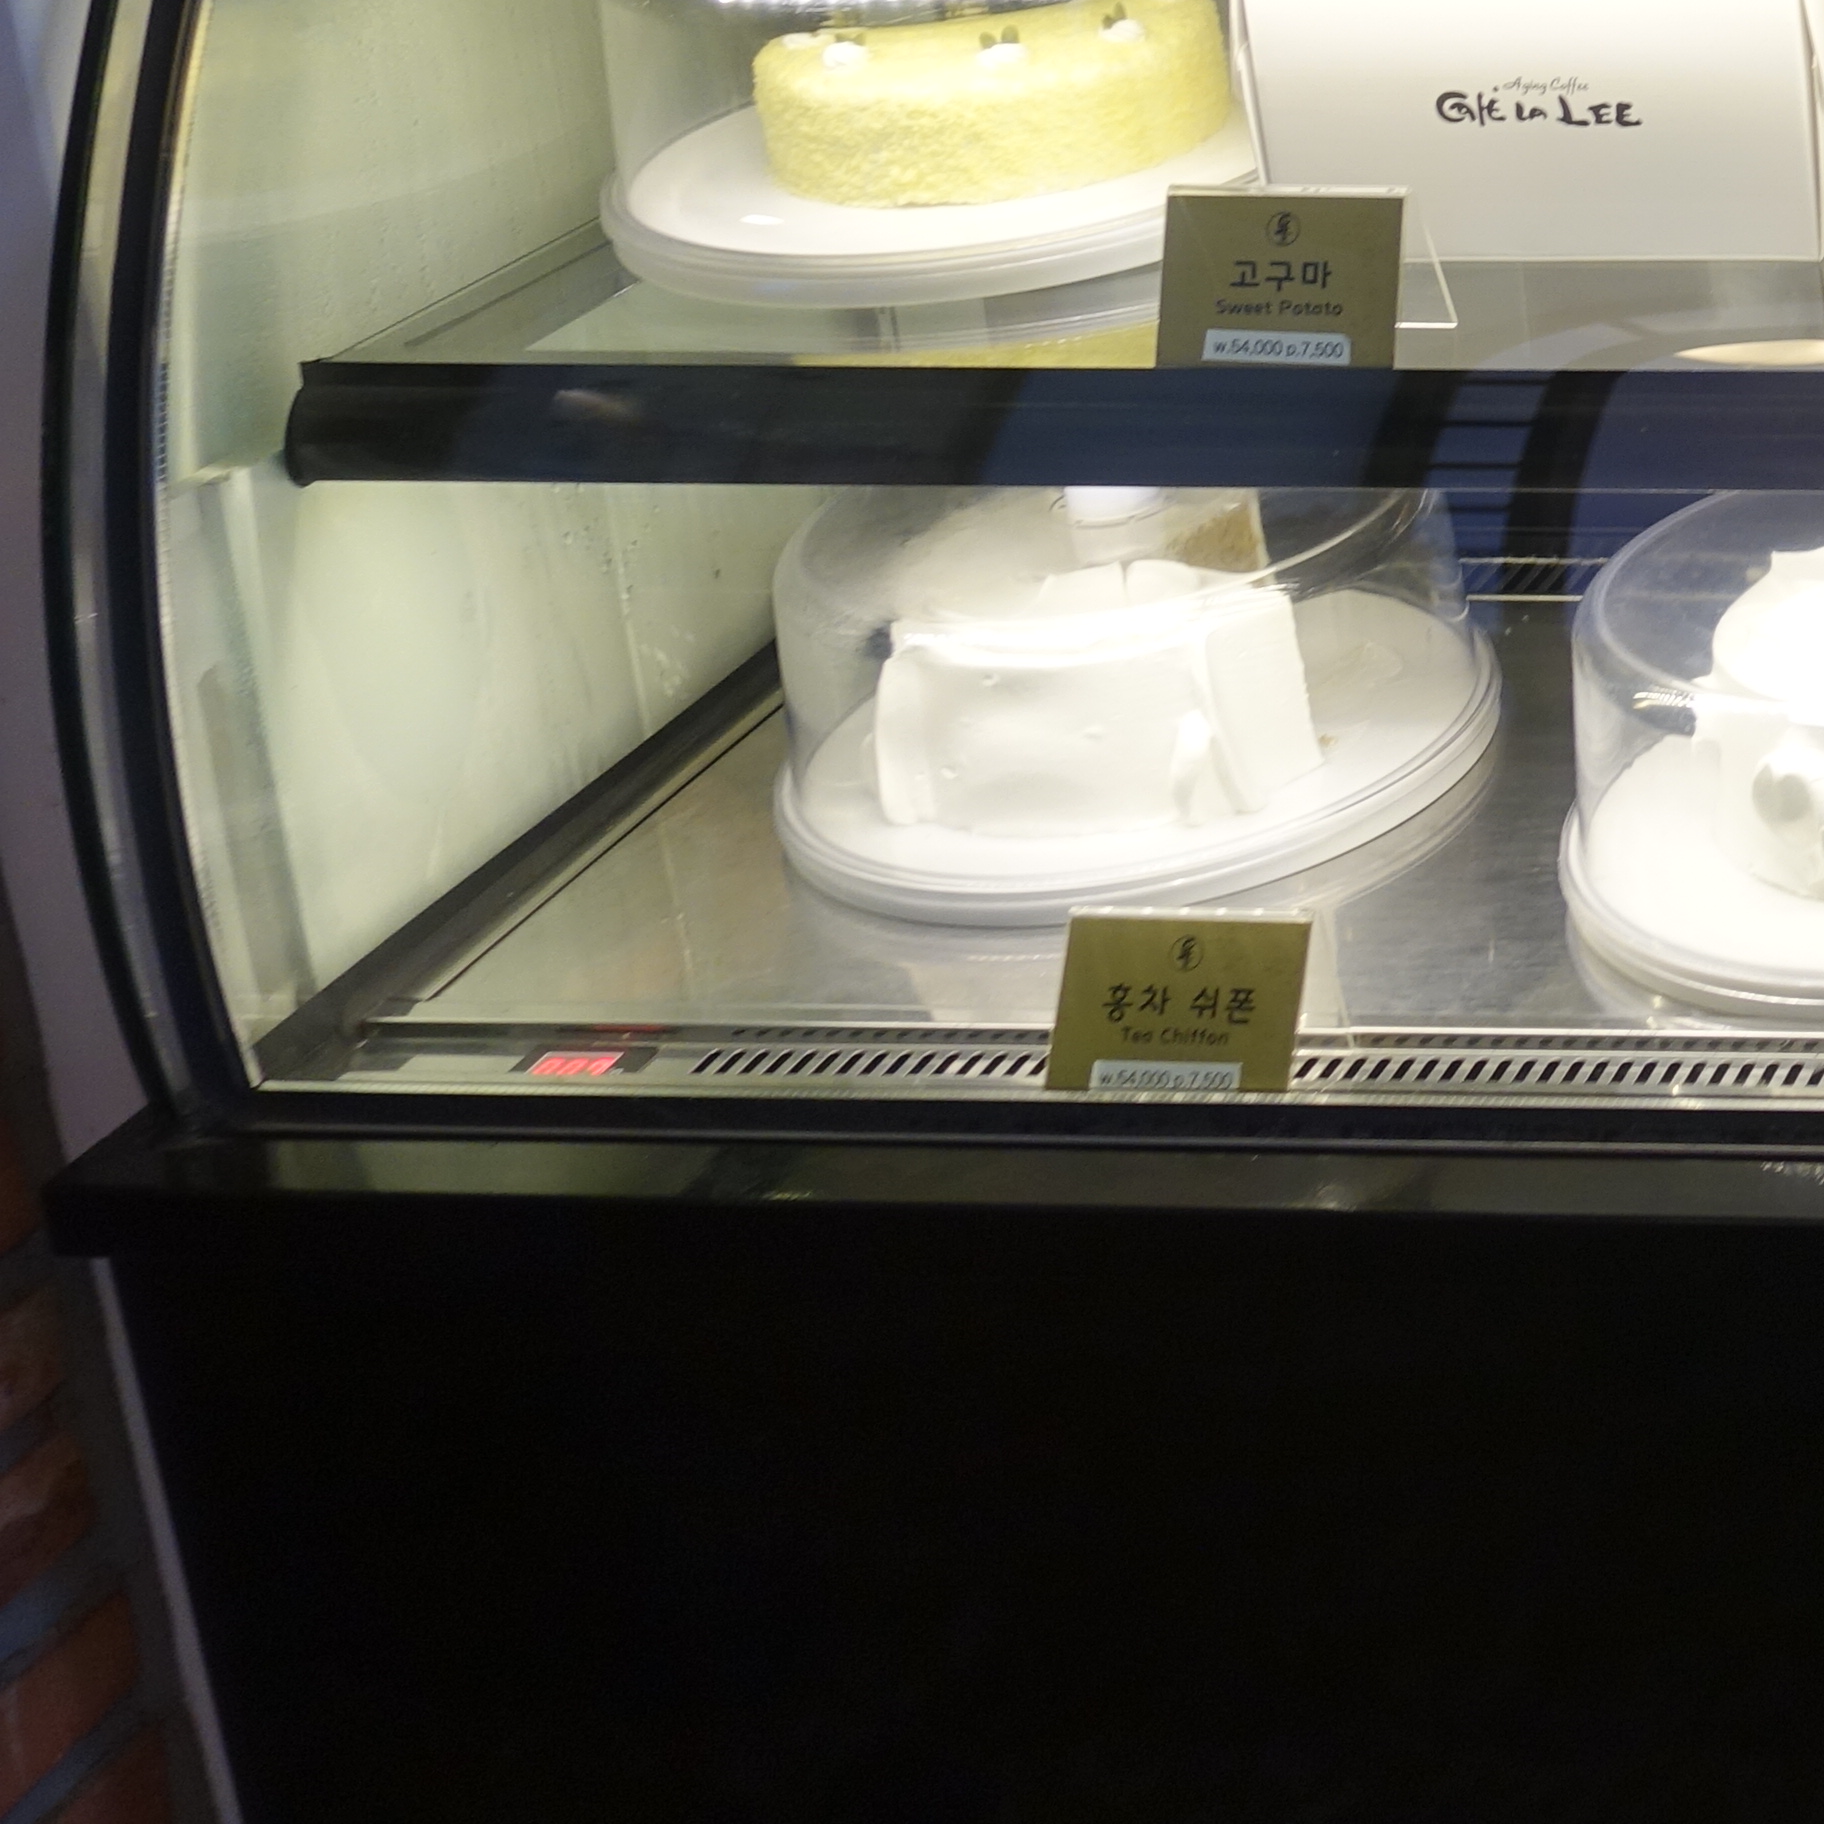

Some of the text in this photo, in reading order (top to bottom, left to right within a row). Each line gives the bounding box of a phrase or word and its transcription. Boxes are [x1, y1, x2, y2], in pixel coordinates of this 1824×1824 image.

[1556, 95, 1643, 127] LEE
[1230, 260, 1332, 292] 고구마
[1215, 299, 1343, 316] Sweet Potato
[1102, 983, 1256, 1024] 홍차 쉬폰
[1121, 1027, 1229, 1045] Tea Chiffon
